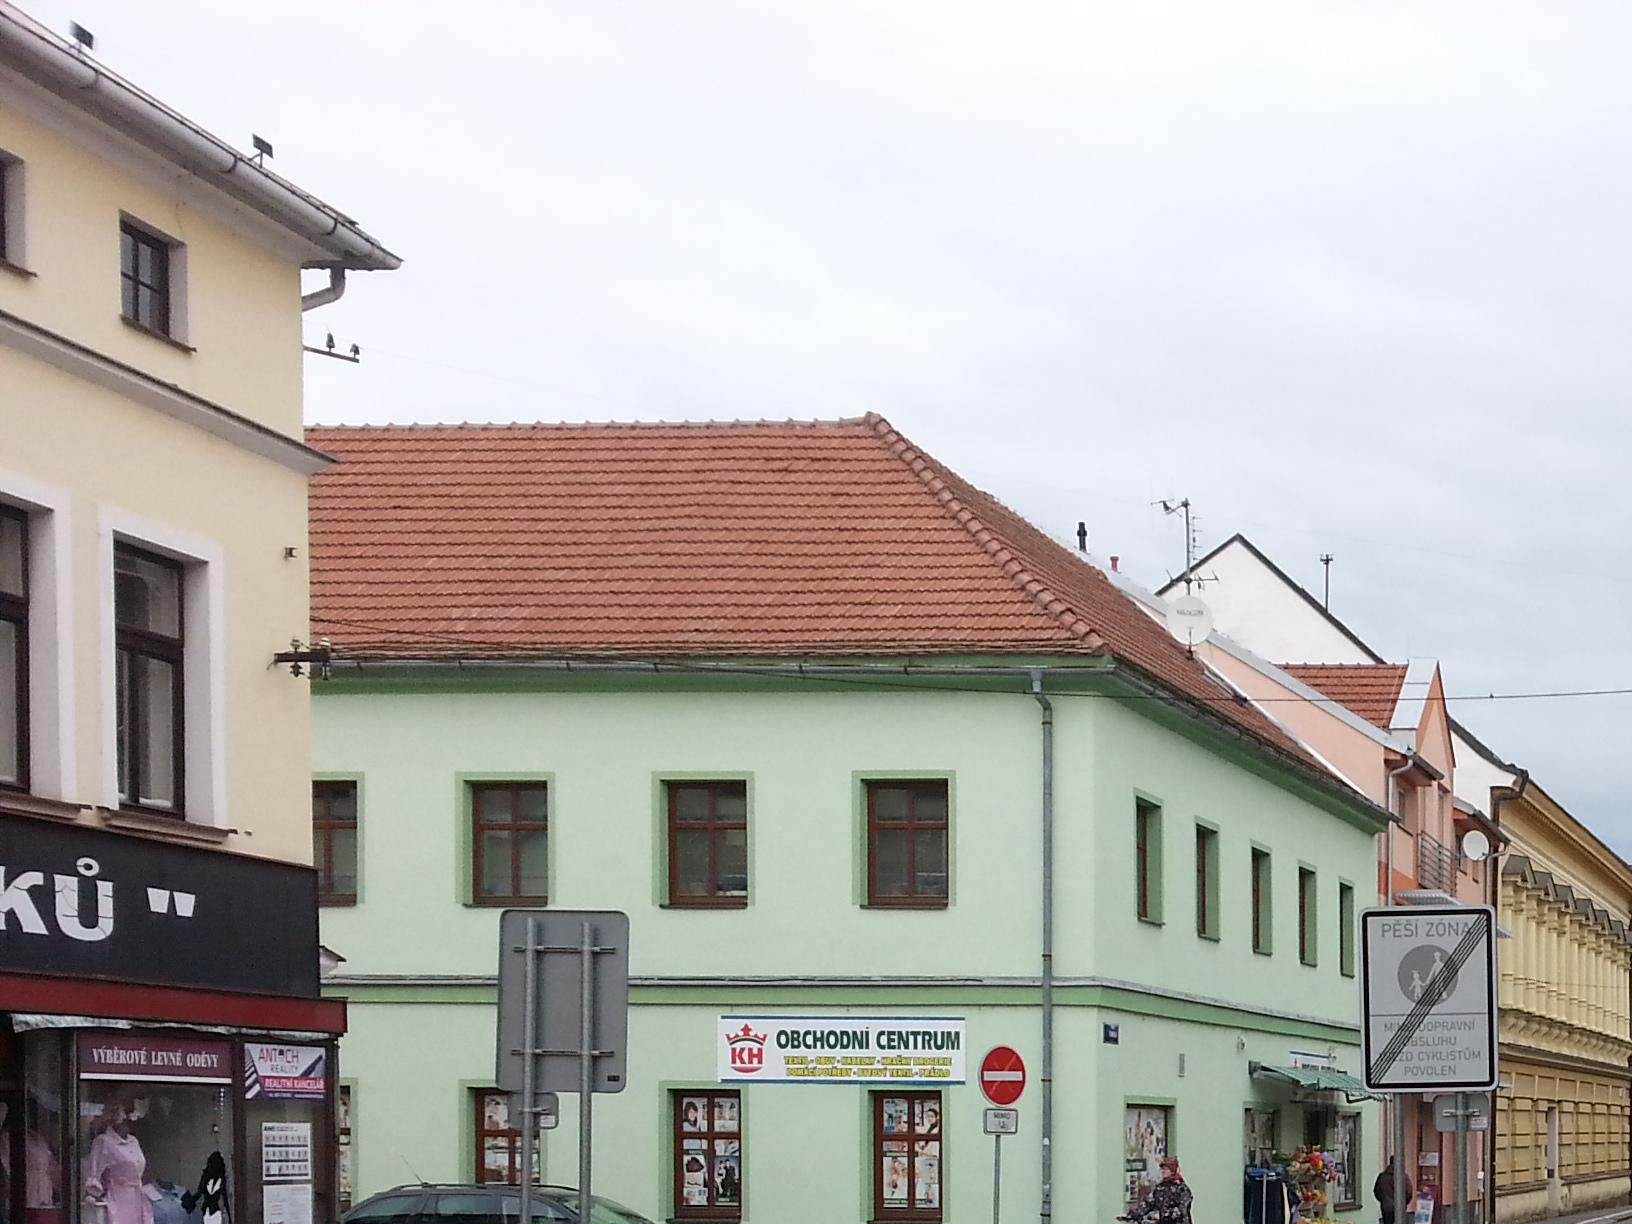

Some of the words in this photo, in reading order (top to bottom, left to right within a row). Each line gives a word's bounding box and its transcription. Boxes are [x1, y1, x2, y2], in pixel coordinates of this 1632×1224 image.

[1381, 919, 1419, 938] PĚŠÍ
[1425, 918, 1474, 937] ZÓNA
[776, 1026, 870, 1050] OBCHODNÍ
[876, 1030, 961, 1050] CENTRUM
[1405, 1036, 1457, 1047] BSLUHU
[92, 1045, 147, 1065] VÝBĚROVÉ
[152, 1049, 182, 1066] LEVNÉ
[187, 1051, 219, 1068] ODĚVY
[731, 1047, 763, 1065] KH
[1418, 1048, 1481, 1062] CYKLISTŮM
[1404, 1065, 1457, 1077] POVOLEN
